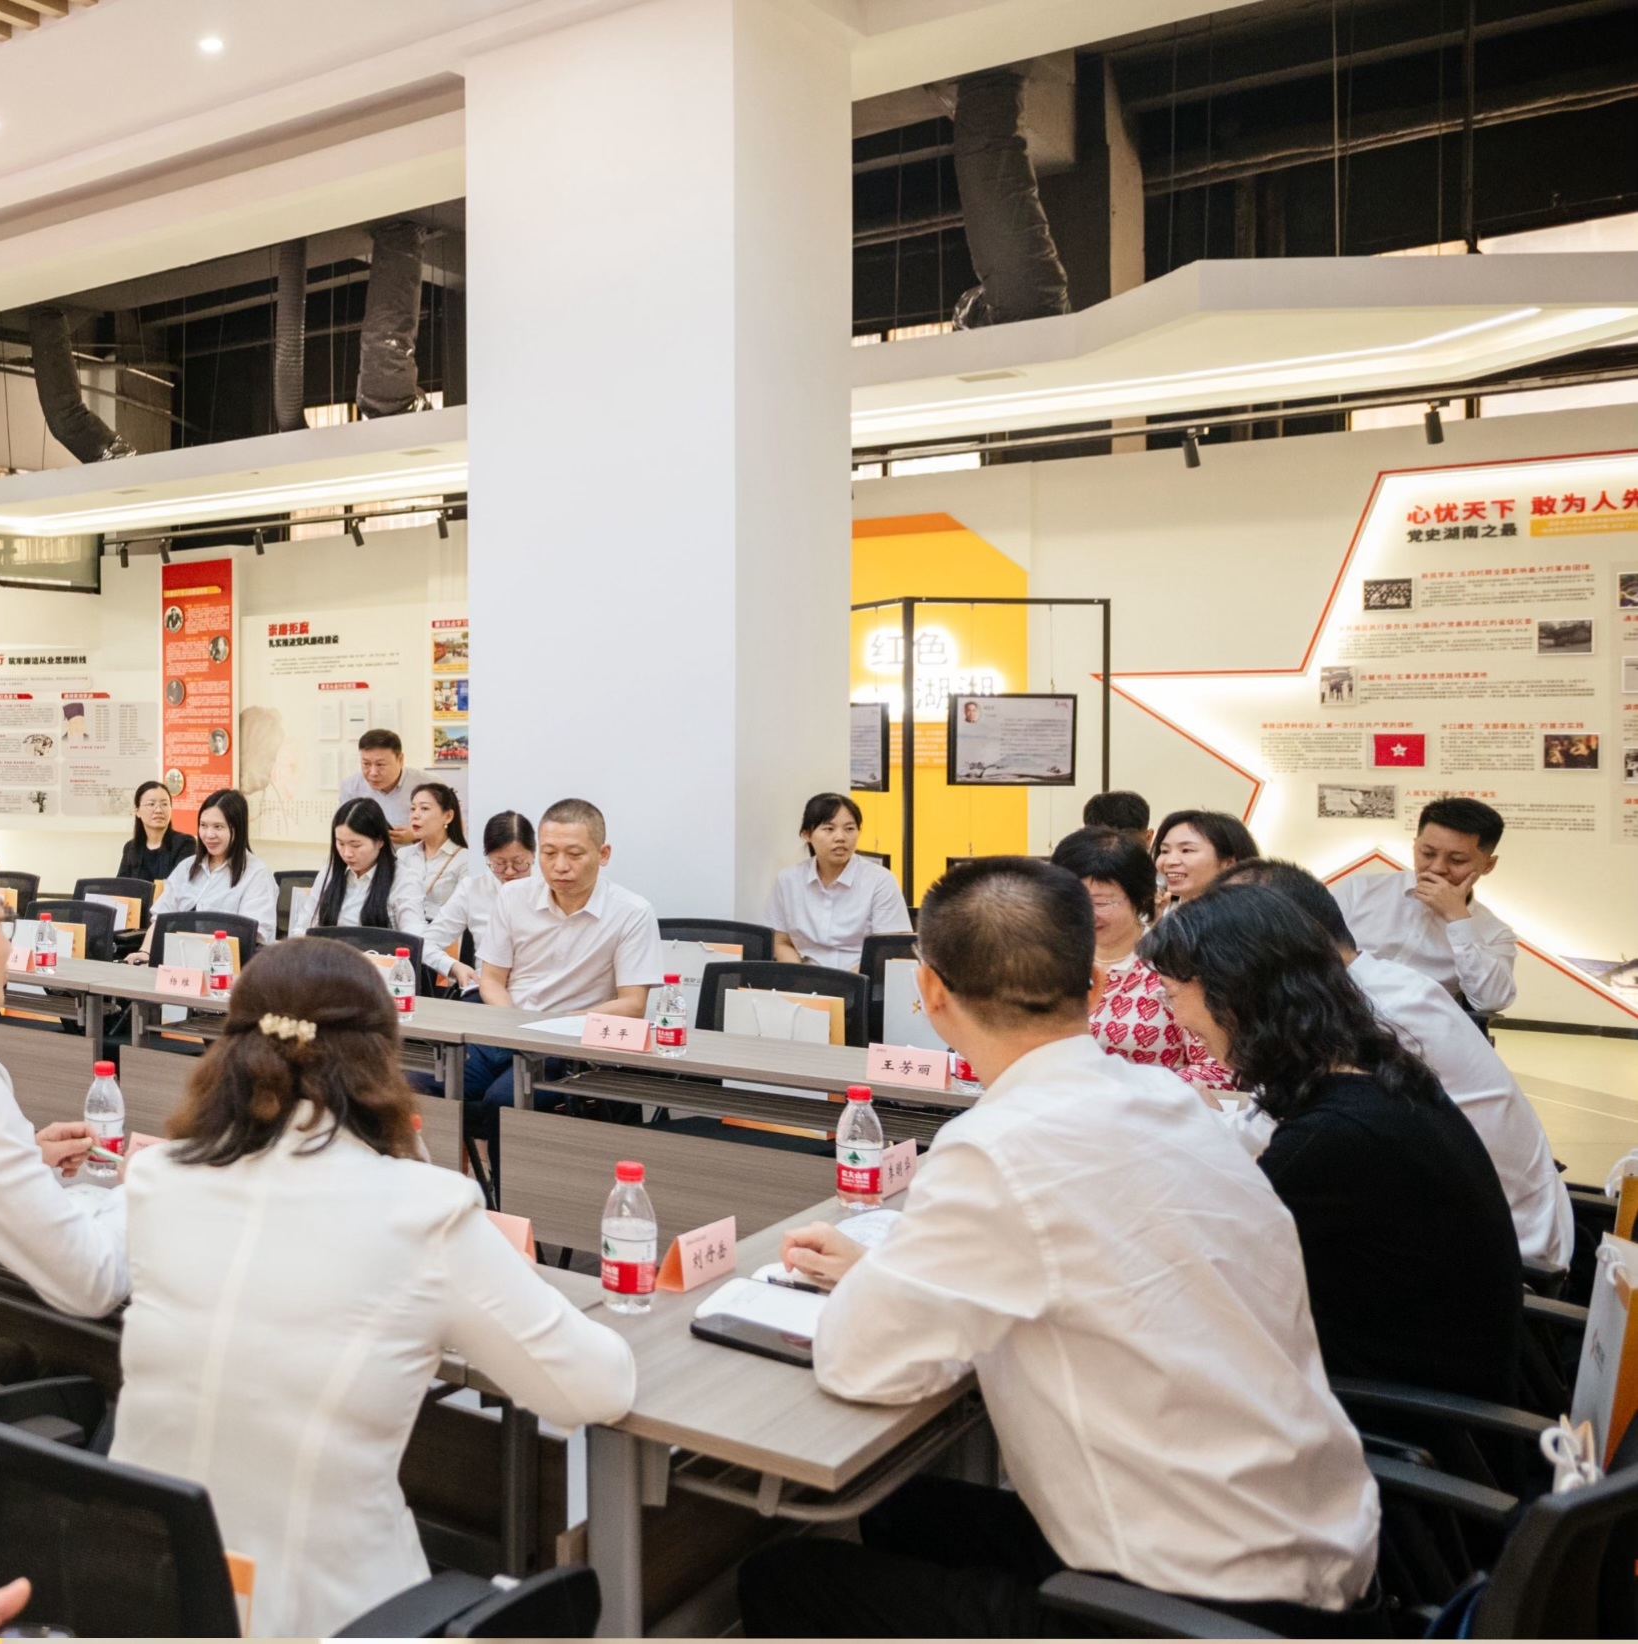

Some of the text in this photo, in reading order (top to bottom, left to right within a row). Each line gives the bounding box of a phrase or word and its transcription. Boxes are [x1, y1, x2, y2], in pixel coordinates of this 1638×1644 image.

[1407, 500, 1516, 525] 心忧天下
[1407, 523, 1517, 543] 党史湖南之最
[268, 621, 309, 636] 崇廉拒腐
[599, 1025, 629, 1041] 李平
[880, 1060, 932, 1076] 王芳丽
